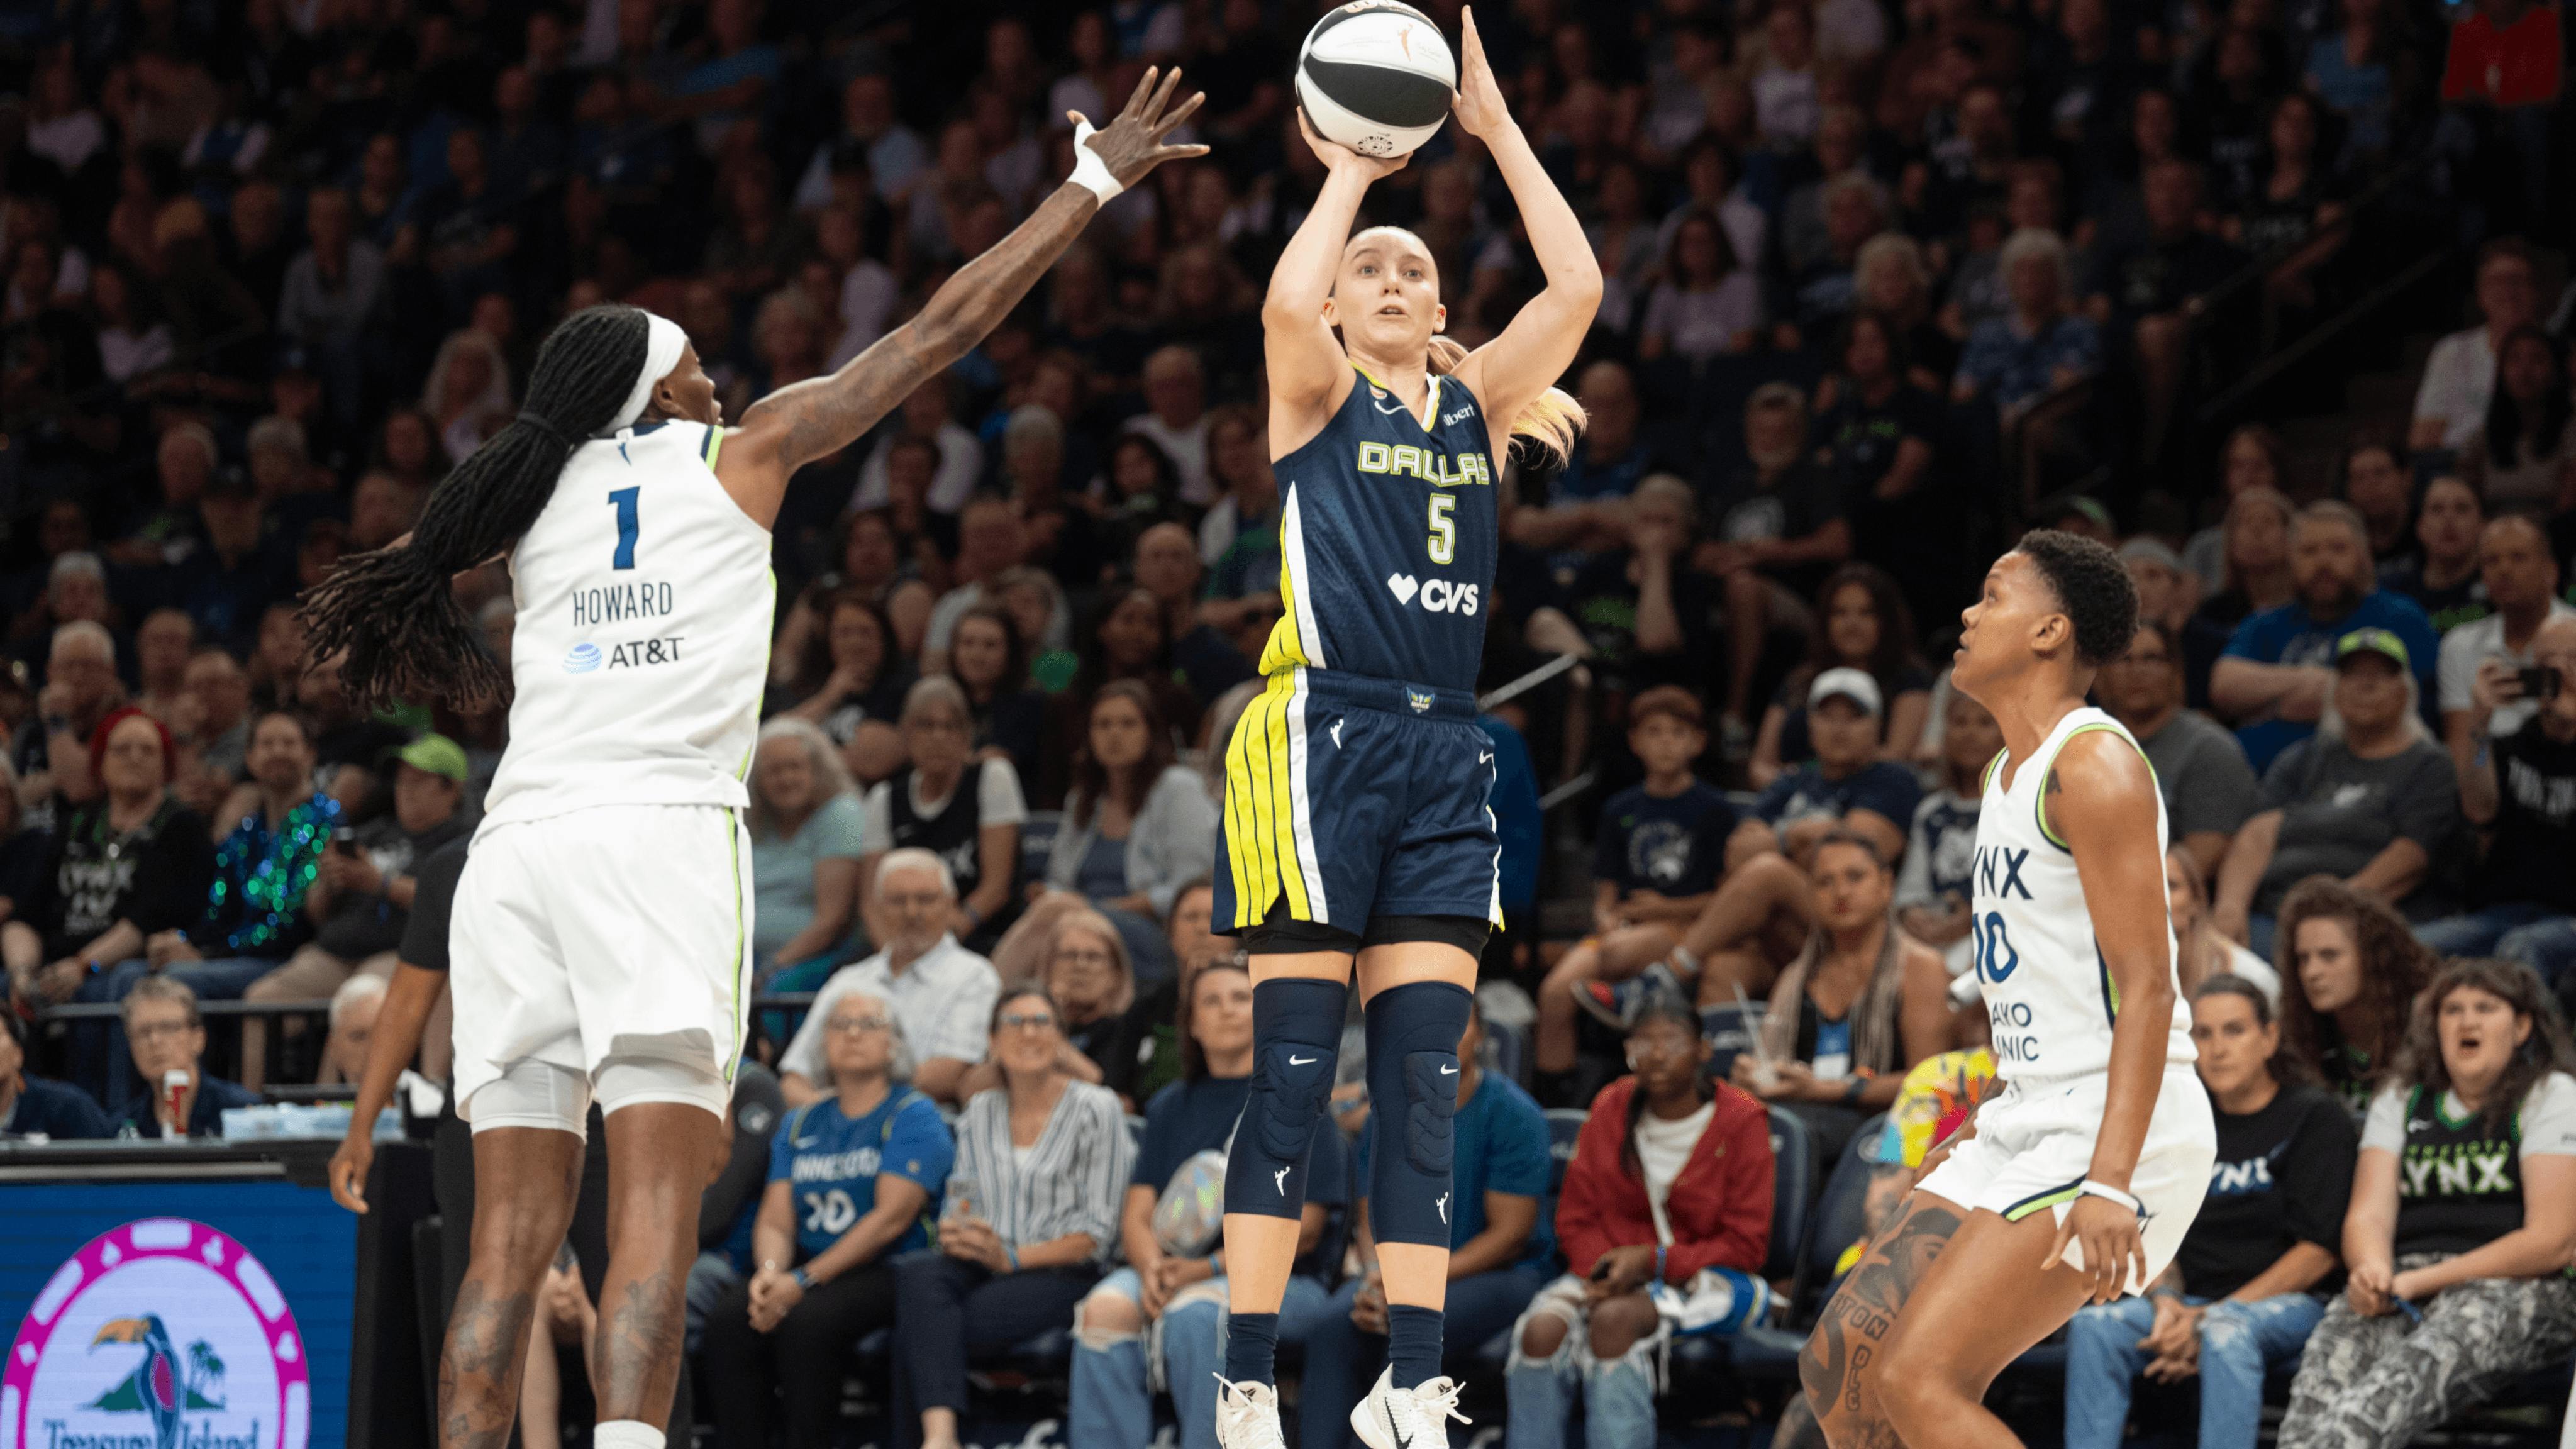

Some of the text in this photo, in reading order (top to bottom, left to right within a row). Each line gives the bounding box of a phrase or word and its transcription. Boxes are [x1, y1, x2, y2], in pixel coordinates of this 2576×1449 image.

[1358, 441, 1490, 488] DALLAS
[607, 486, 641, 570] 1
[1428, 492, 1456, 564] 5
[573, 582, 674, 627] HOWARD
[1420, 578, 1479, 616] CVS
[608, 637, 685, 670] AT&T
[1992, 1002, 2032, 1028] AYO
[1996, 1035, 2039, 1062] INIC
[2400, 1153, 2515, 1195] YNX
